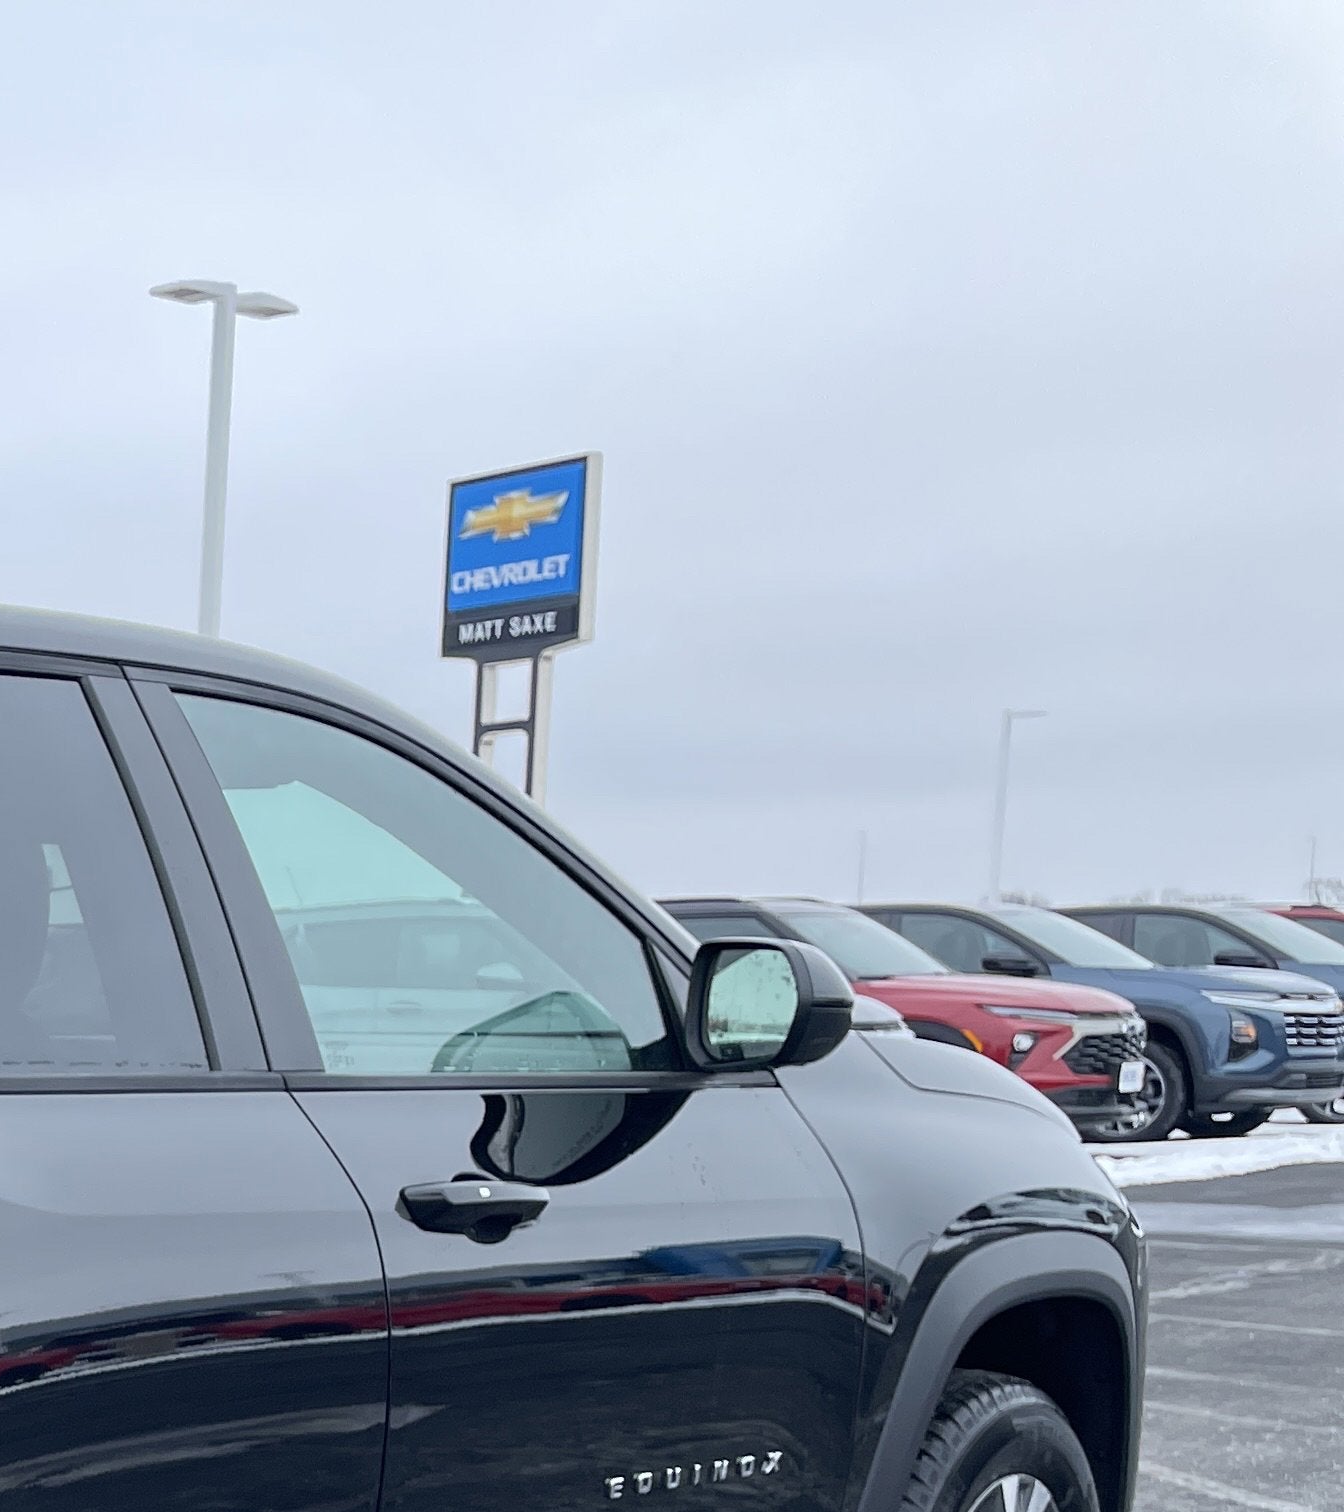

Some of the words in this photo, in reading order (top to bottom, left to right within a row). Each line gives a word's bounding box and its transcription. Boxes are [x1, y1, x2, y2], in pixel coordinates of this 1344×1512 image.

[451, 554, 571, 594] CHEVROLET
[458, 618, 505, 644] MATT
[508, 611, 557, 637] SAXE
[605, 1451, 783, 1499] EQUINOX
